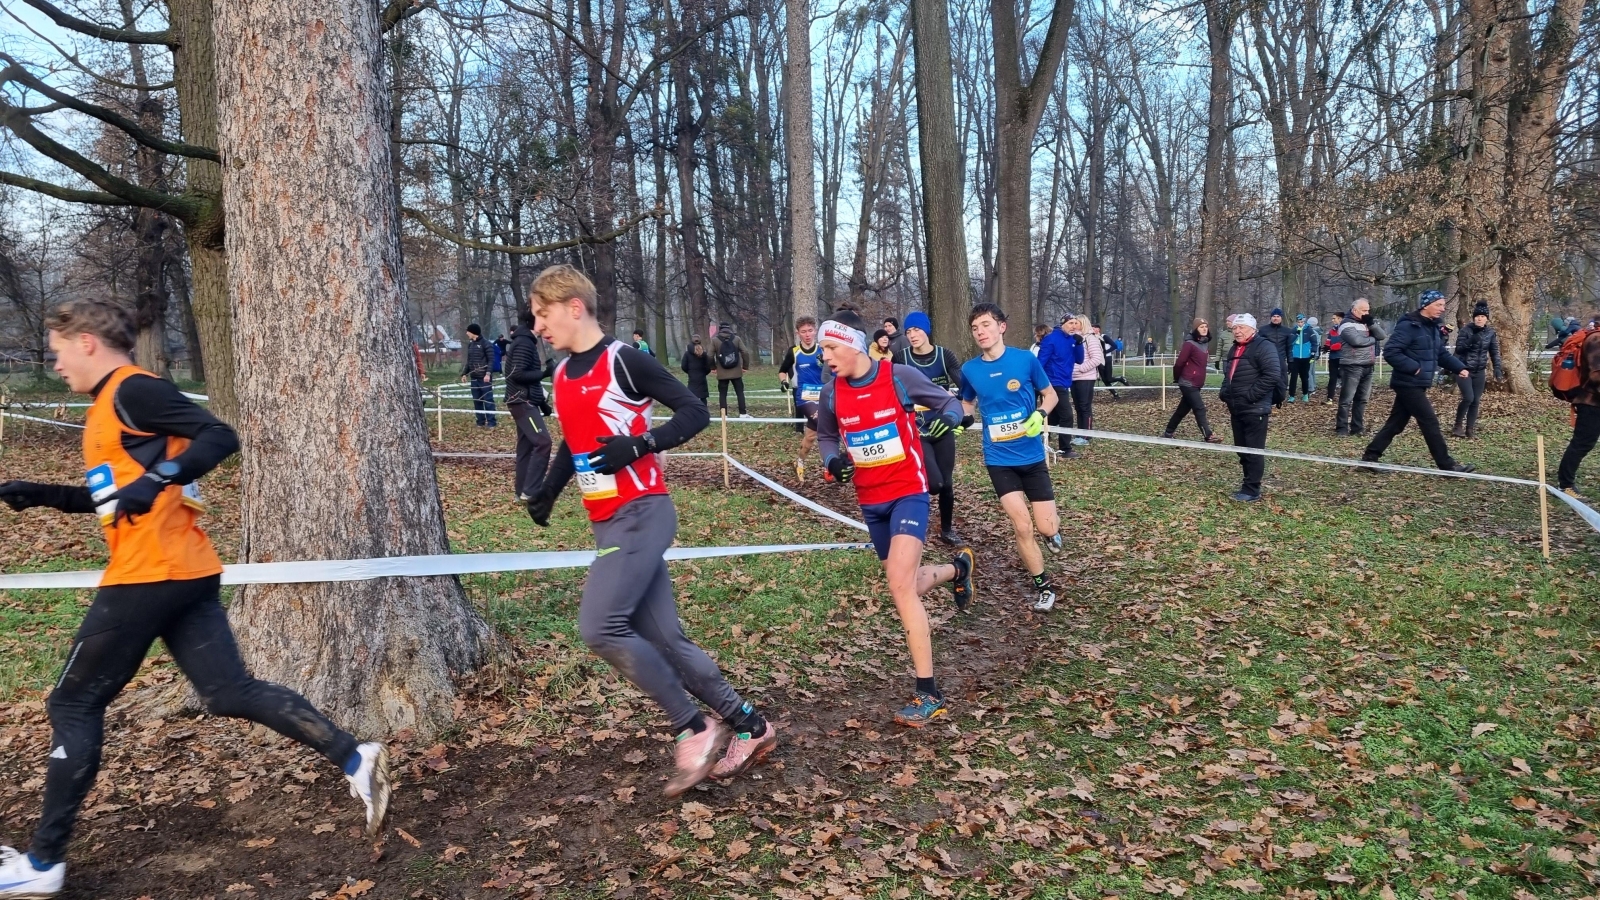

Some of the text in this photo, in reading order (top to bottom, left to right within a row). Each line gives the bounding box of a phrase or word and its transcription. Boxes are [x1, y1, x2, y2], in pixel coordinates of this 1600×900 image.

[825, 328, 854, 343] MARATON
[1000, 423, 1018, 432] 858
[862, 444, 885, 457] 868
